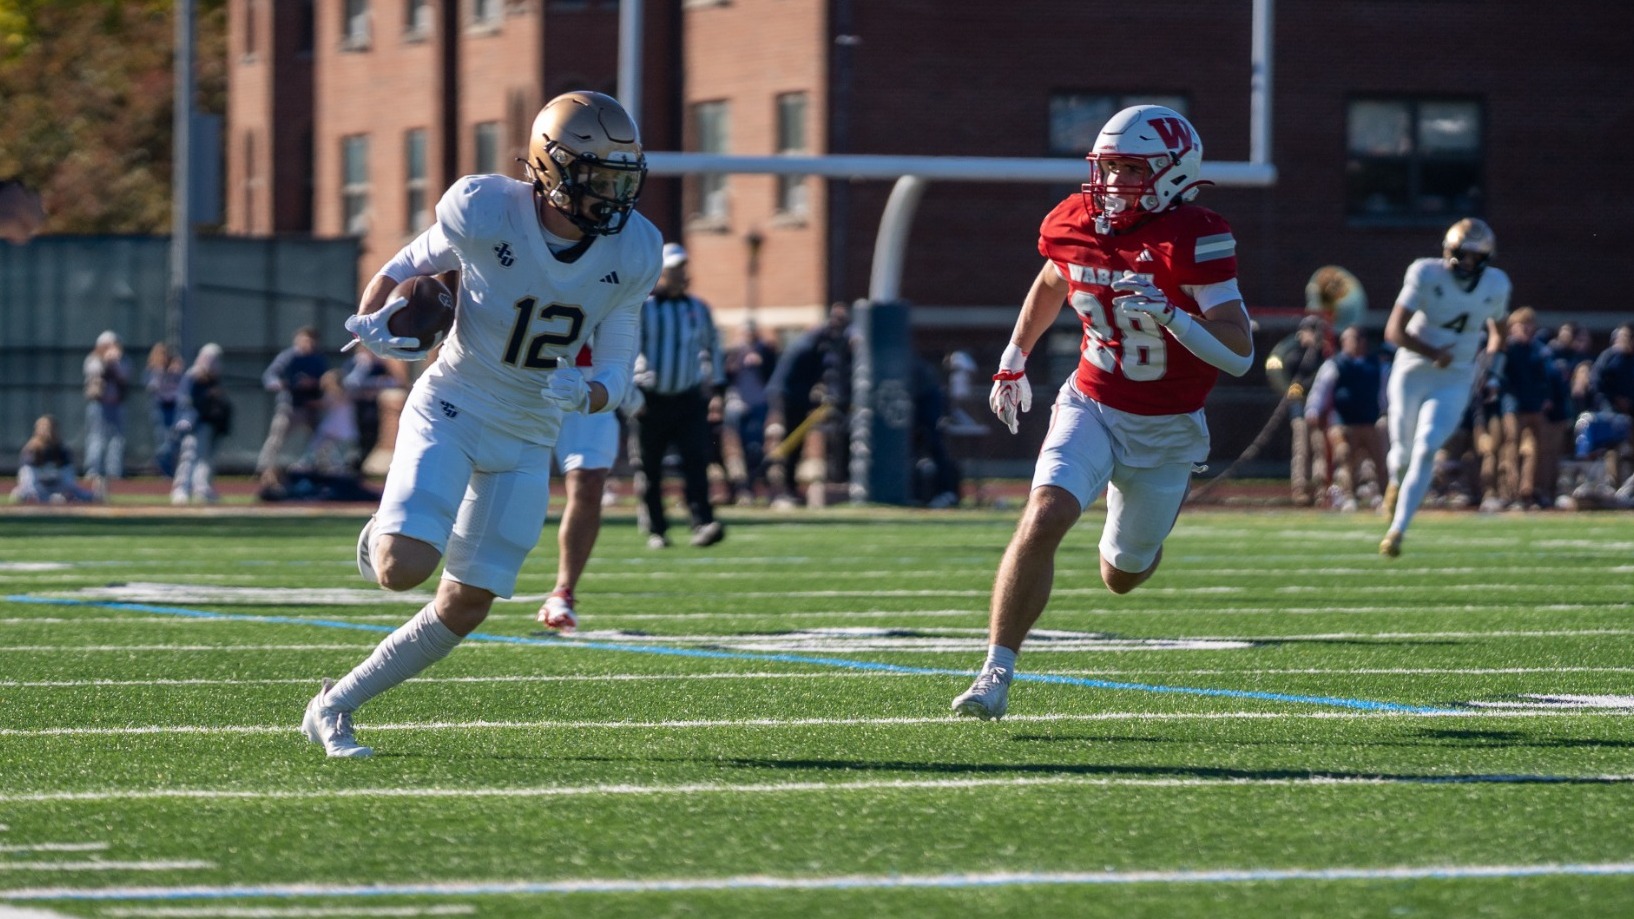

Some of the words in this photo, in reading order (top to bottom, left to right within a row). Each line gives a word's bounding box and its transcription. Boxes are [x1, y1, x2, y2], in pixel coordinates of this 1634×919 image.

[1146, 117, 1193, 150] W
[502, 295, 586, 370] 12
[1070, 289, 1167, 382] 28
[1440, 312, 1470, 334] 4
